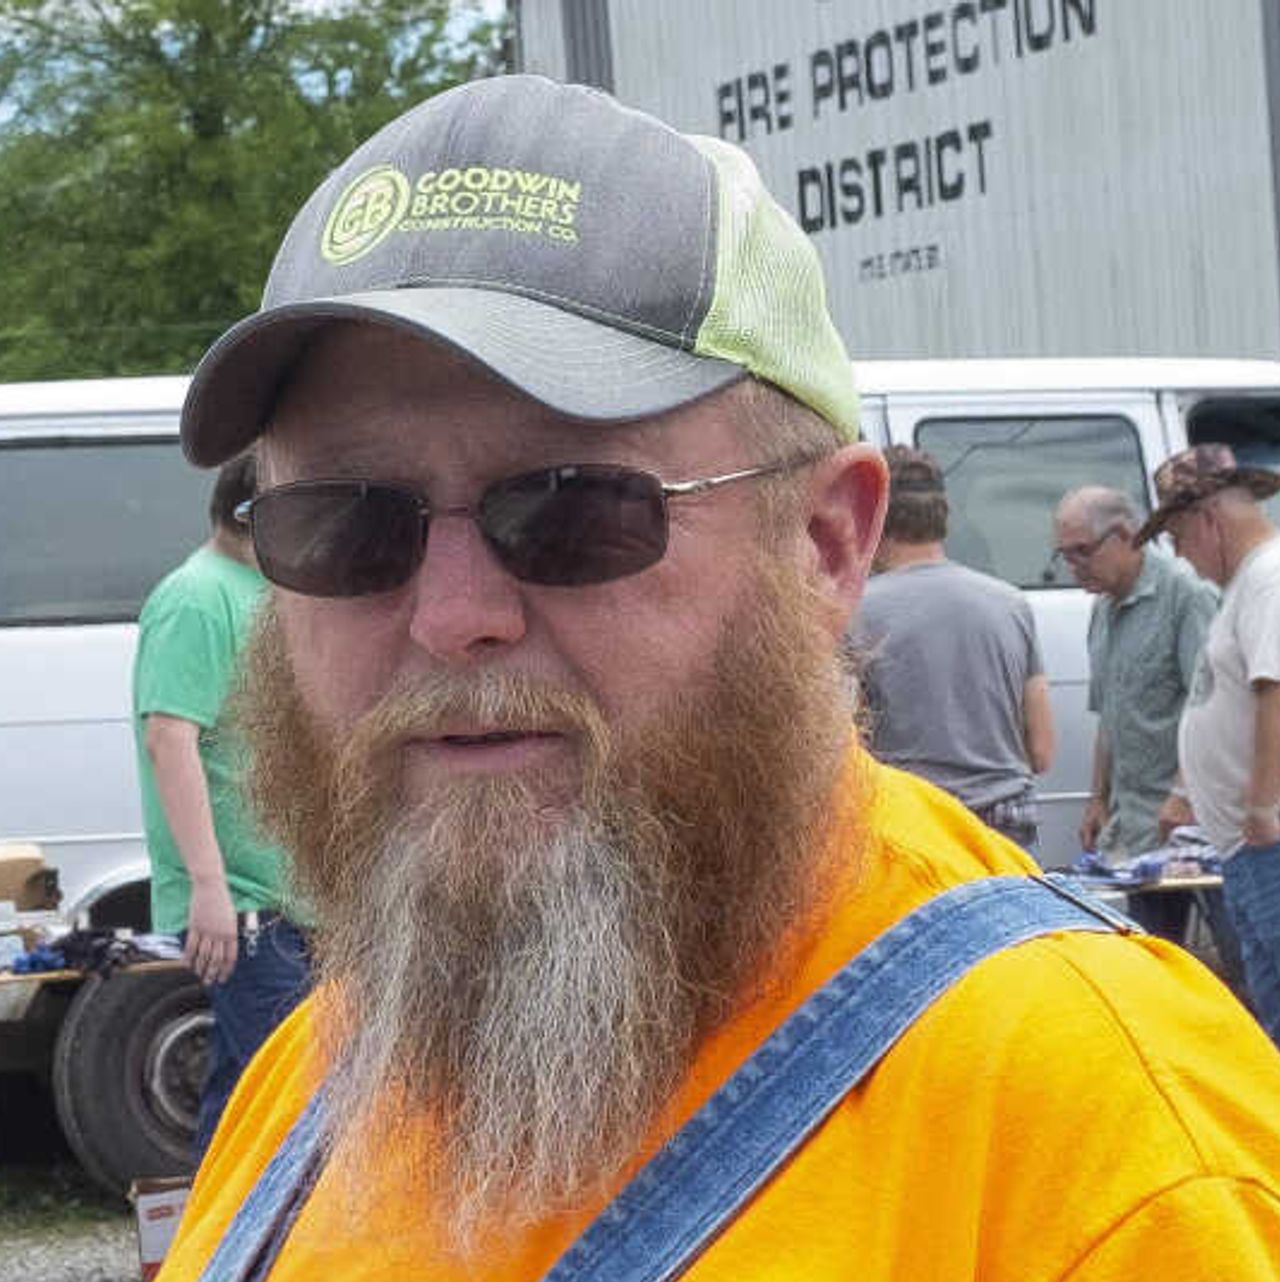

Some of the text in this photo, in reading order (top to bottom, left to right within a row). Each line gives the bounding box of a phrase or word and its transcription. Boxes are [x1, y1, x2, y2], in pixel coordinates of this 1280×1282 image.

[717, 0, 1097, 142] FIRE PROTECTION
[416, 167, 582, 201] GOODWIN
[797, 120, 993, 235] DISTRICT
[398, 215, 545, 233] CONSTRUCTION
[410, 191, 577, 225] BROTHERS
